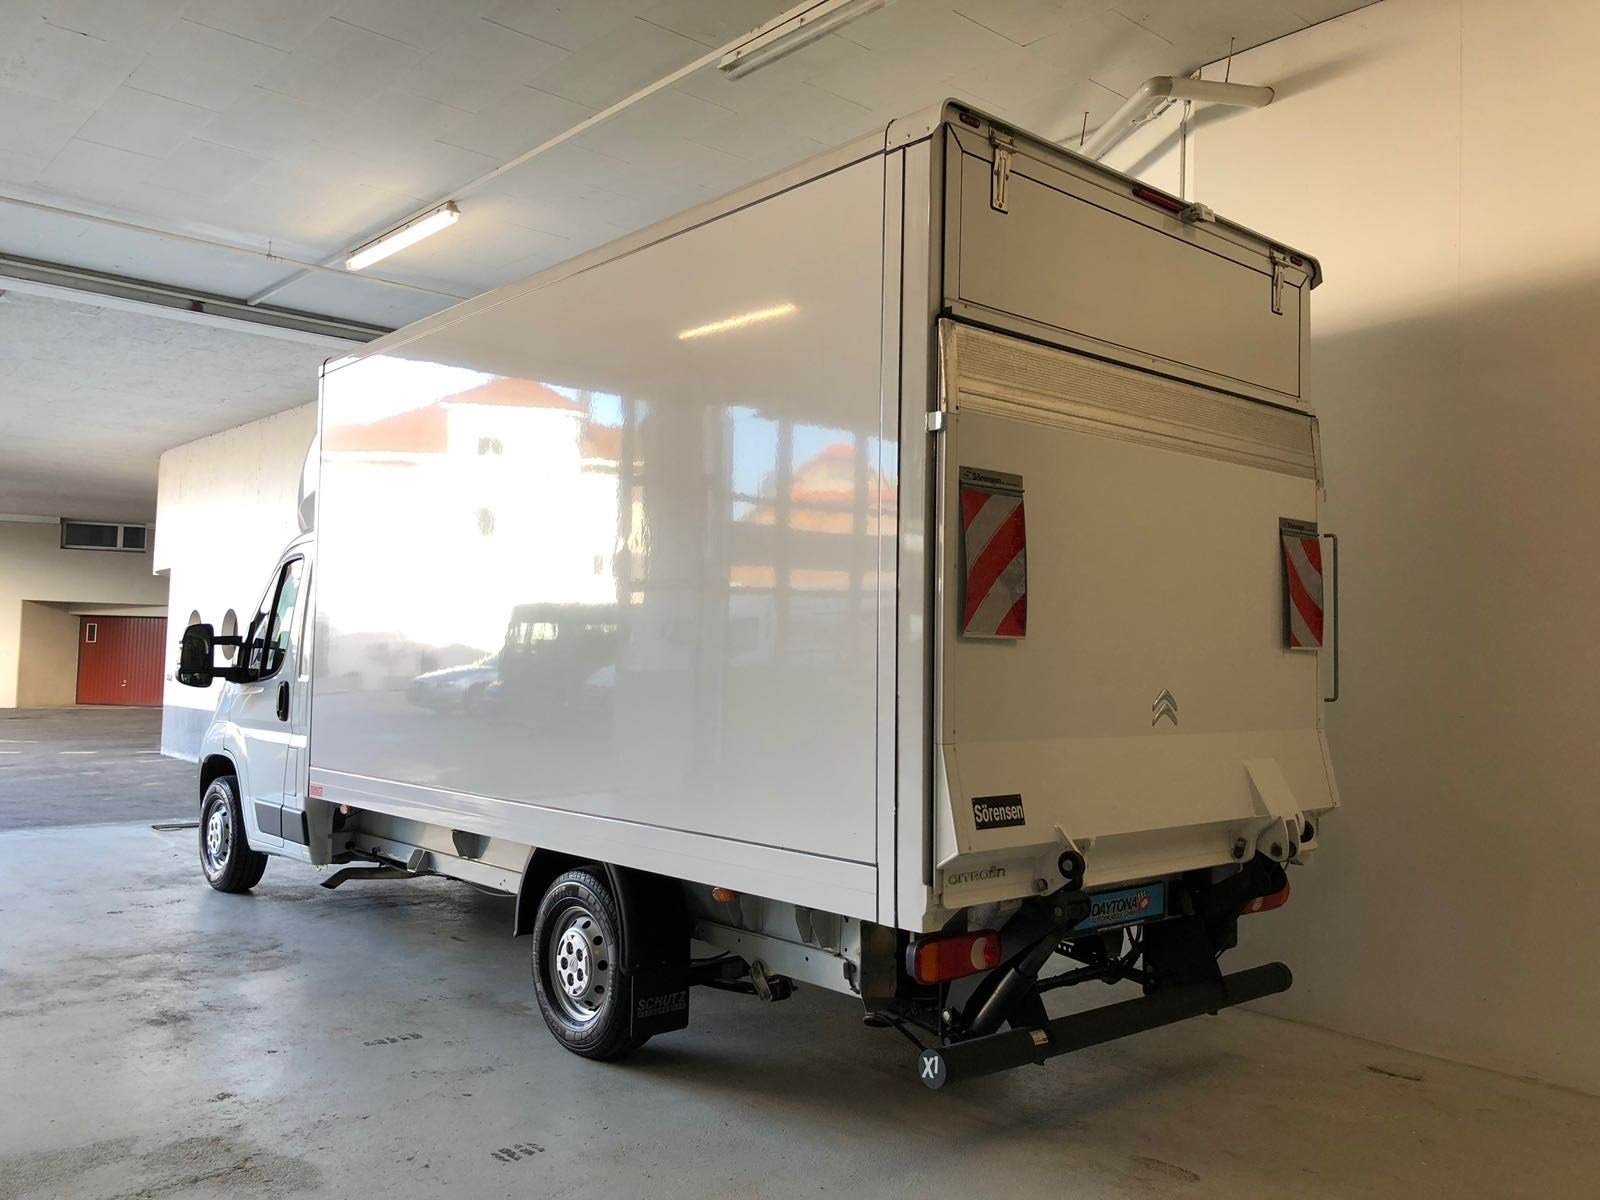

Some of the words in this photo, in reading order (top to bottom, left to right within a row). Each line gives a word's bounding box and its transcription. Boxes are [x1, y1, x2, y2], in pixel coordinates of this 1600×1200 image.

[974, 804, 1024, 823] Sörensen
[1091, 896, 1138, 917] DAYTONA
[638, 991, 686, 1011] SCHUTZ
[921, 1055, 939, 1078] X1
